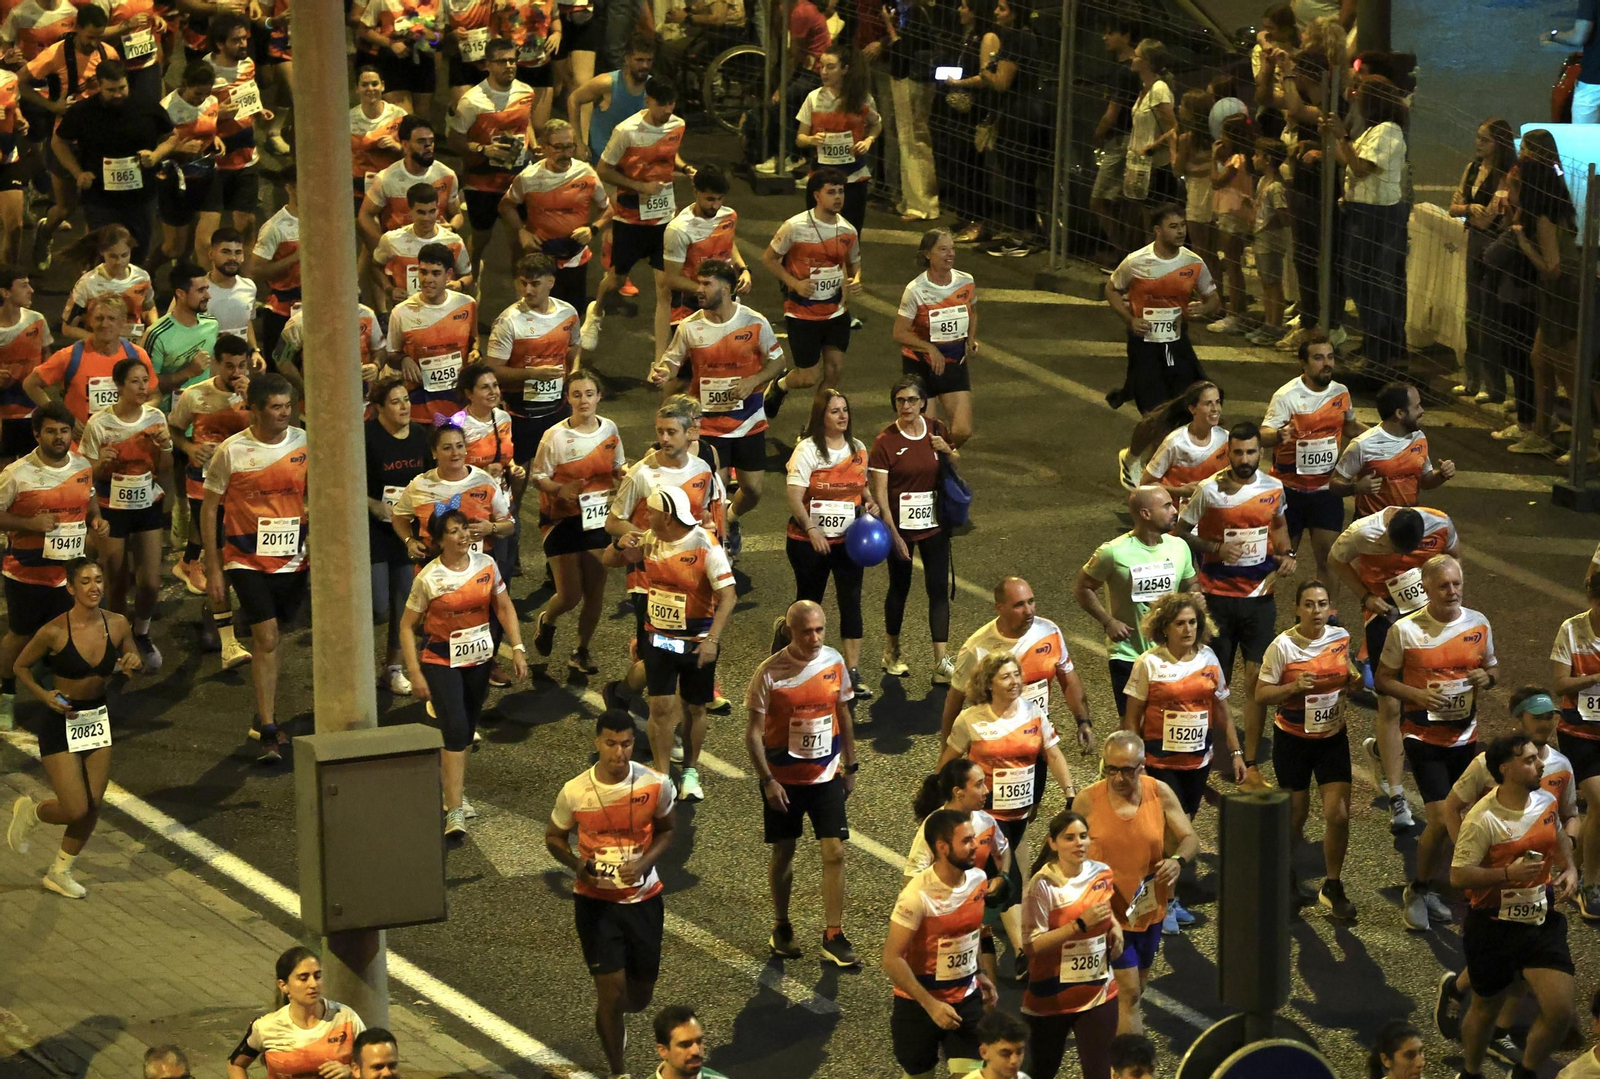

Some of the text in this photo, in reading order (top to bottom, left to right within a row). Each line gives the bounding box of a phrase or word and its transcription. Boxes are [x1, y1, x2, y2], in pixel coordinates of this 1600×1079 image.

[235, 94, 257, 108] 1906
[822, 144, 850, 156] 12086
[110, 170, 134, 182] 1865
[647, 198, 668, 210] 6596
[940, 321, 958, 333] 851
[430, 368, 456, 381] 4258
[532, 380, 556, 392] 4334
[1302, 452, 1333, 465] 15049
[119, 488, 146, 500] 6815
[908, 508, 931, 519] 2662
[818, 515, 846, 528] 2687
[50, 538, 82, 550] 19418
[262, 534, 294, 546] 20112
[1137, 578, 1170, 592] 12549
[1398, 582, 1424, 602] 1693
[651, 604, 679, 620] 15074
[455, 640, 488, 656] 20110
[70, 723, 104, 740] 20823
[1168, 728, 1203, 741] 15204
[803, 734, 822, 747] 871
[998, 782, 1030, 798] 13632
[601, 863, 621, 877] 22
[1506, 903, 1541, 917] 15914
[948, 950, 973, 968] 3287
[1071, 955, 1100, 970] 3286
